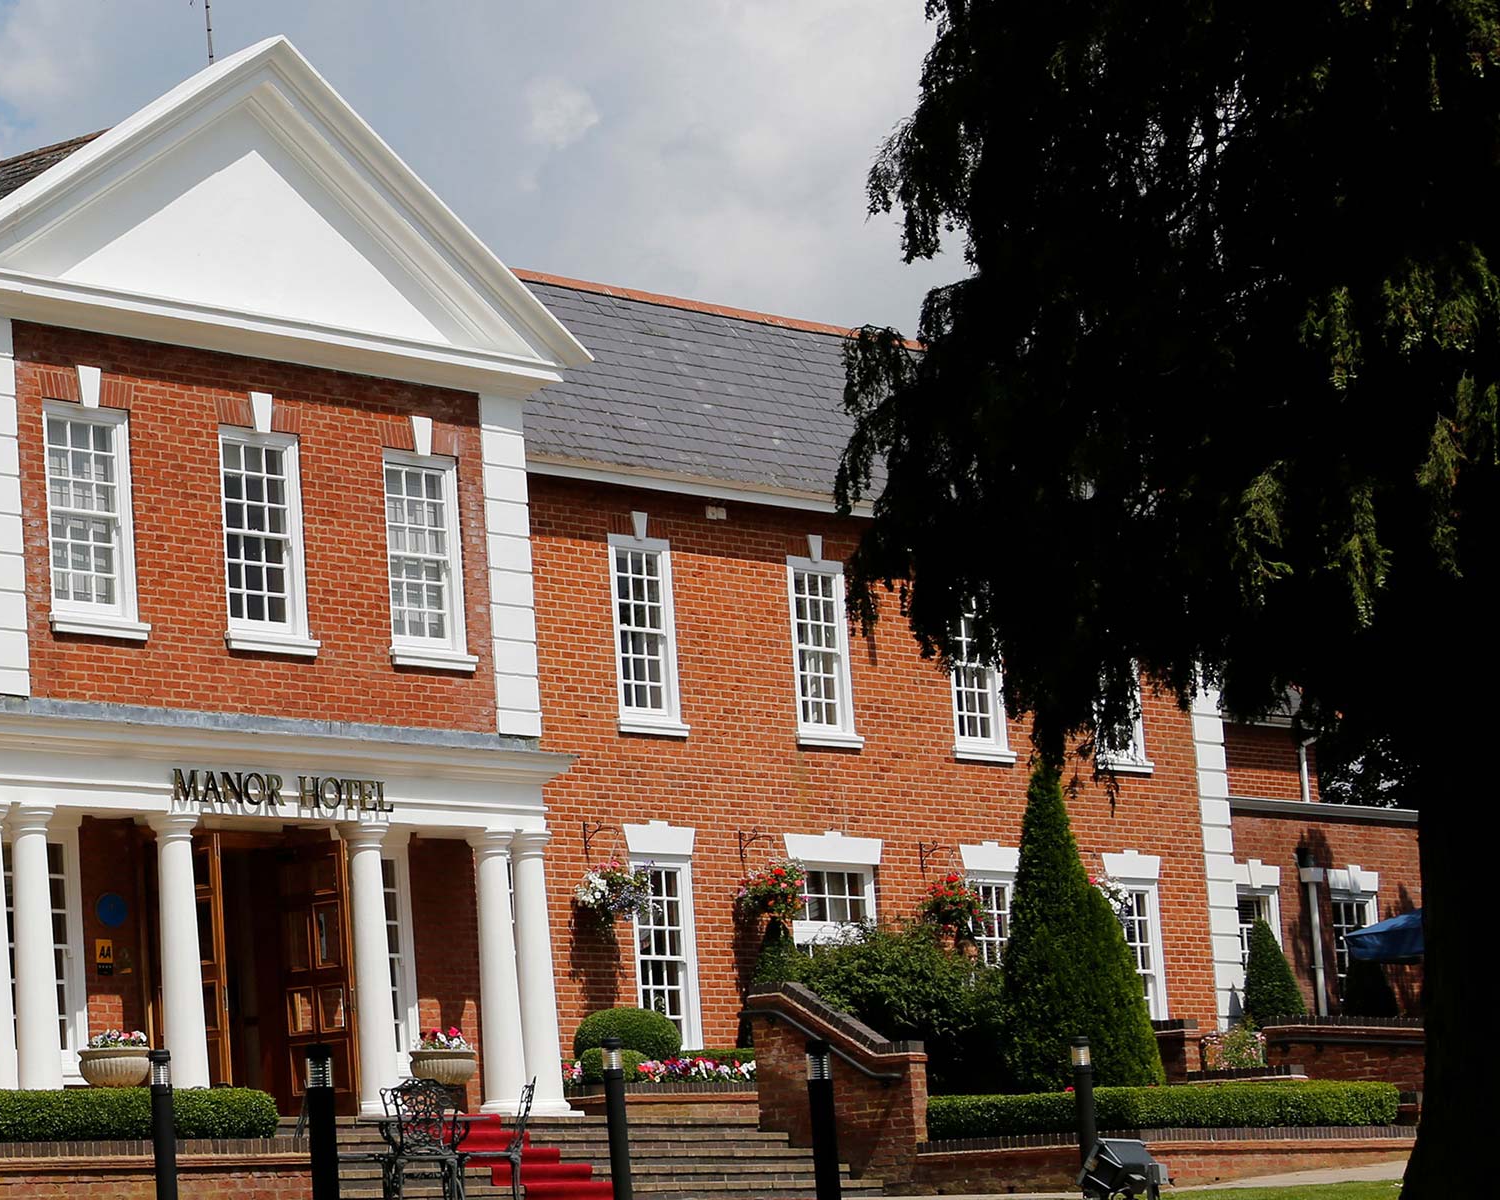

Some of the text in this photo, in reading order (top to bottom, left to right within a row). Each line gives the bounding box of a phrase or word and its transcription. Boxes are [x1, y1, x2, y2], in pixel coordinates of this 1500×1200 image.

[172, 768, 394, 813] MANOR HOTEL
[99, 945, 111, 959] AA
